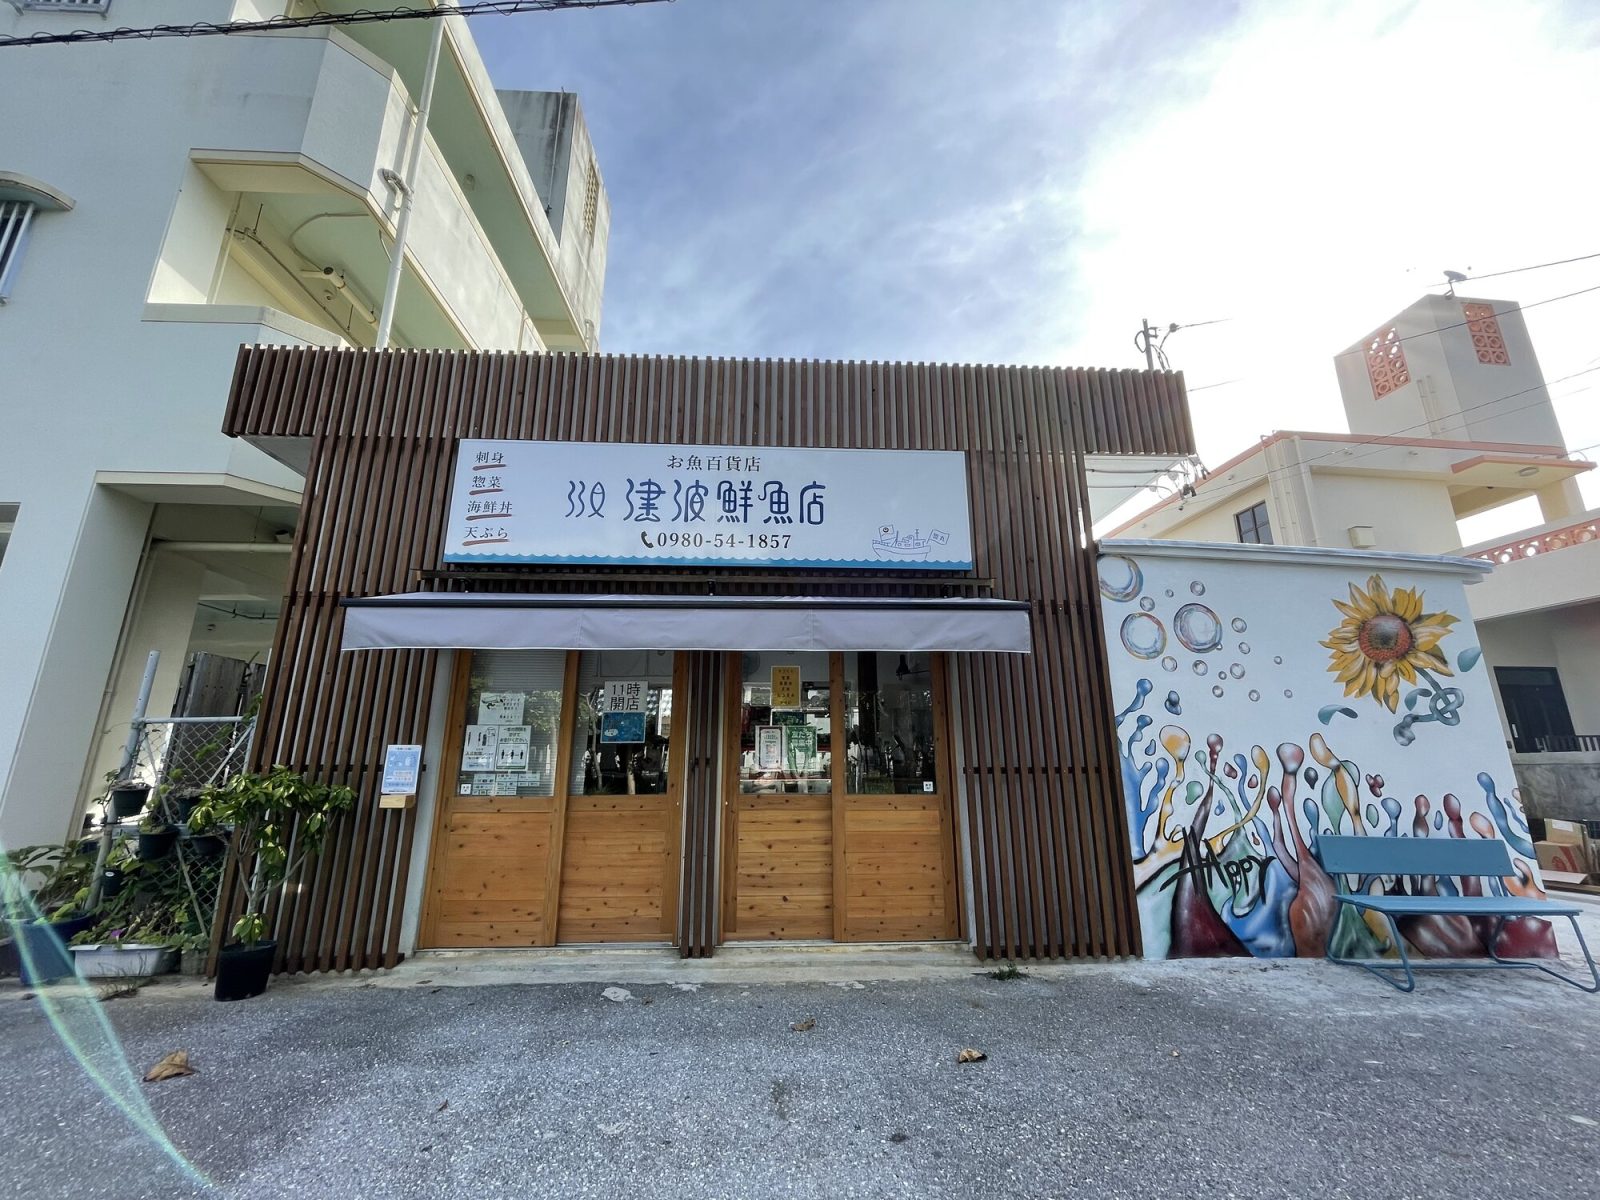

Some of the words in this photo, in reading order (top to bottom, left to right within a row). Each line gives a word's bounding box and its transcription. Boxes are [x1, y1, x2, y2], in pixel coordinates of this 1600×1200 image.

[475, 451, 504, 463] 刺身
[667, 454, 761, 472] お魚百貨店
[472, 475, 502, 488] 惣菜
[467, 500, 513, 514] 海鮮丼
[657, 532, 791, 549] 0980-54-1857
[612, 682, 641, 697] 11時
[610, 695, 640, 711] 開店
